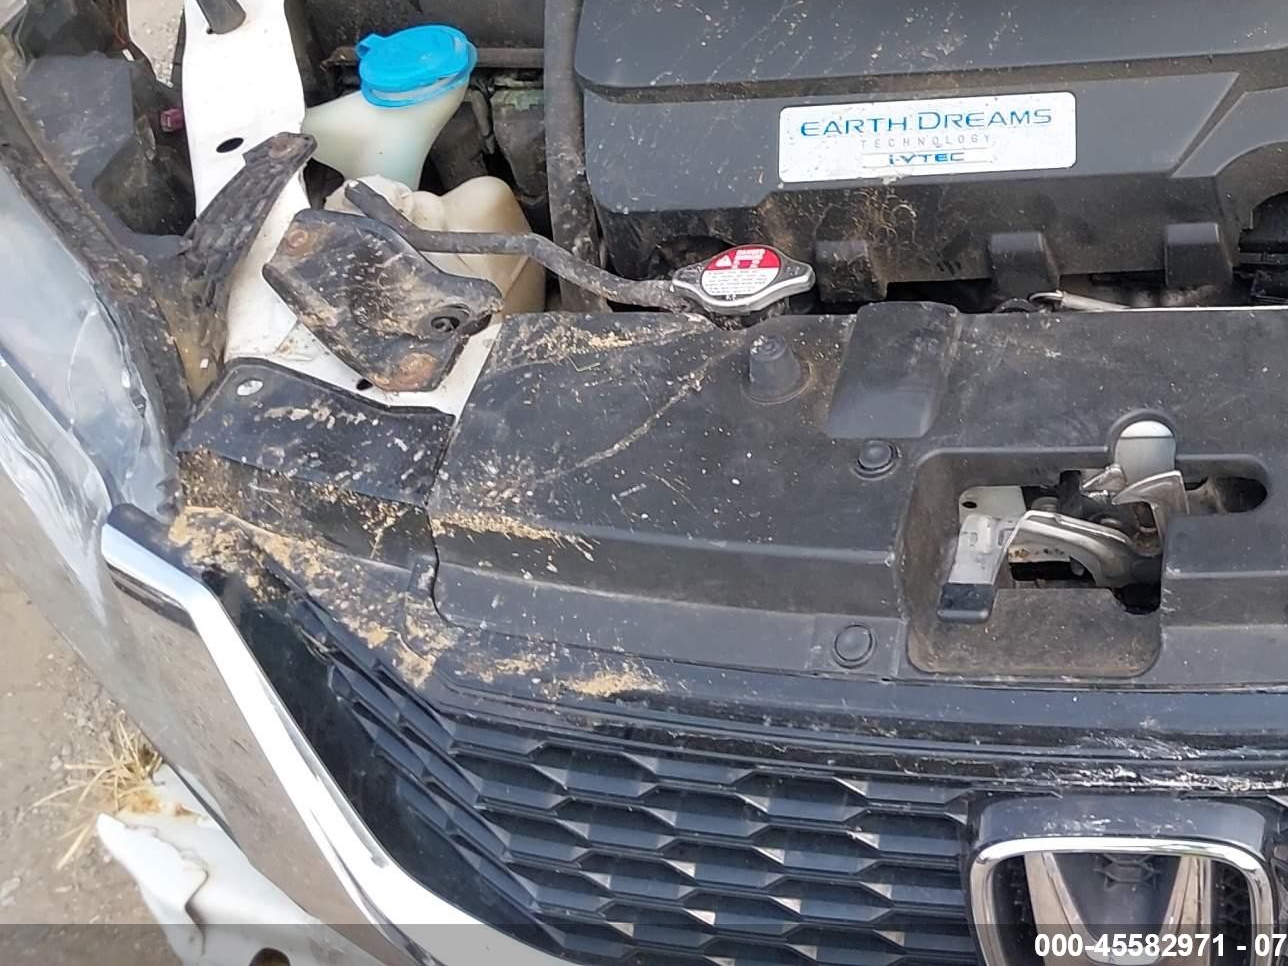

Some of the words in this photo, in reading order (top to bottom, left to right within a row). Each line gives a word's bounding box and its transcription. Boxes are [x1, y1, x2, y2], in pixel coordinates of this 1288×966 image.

[800, 116, 907, 137] EARTH
[917, 109, 1052, 131] DREAMS
[861, 134, 992, 149] TECHNOLOGY
[888, 152, 965, 165] i-VTEC
